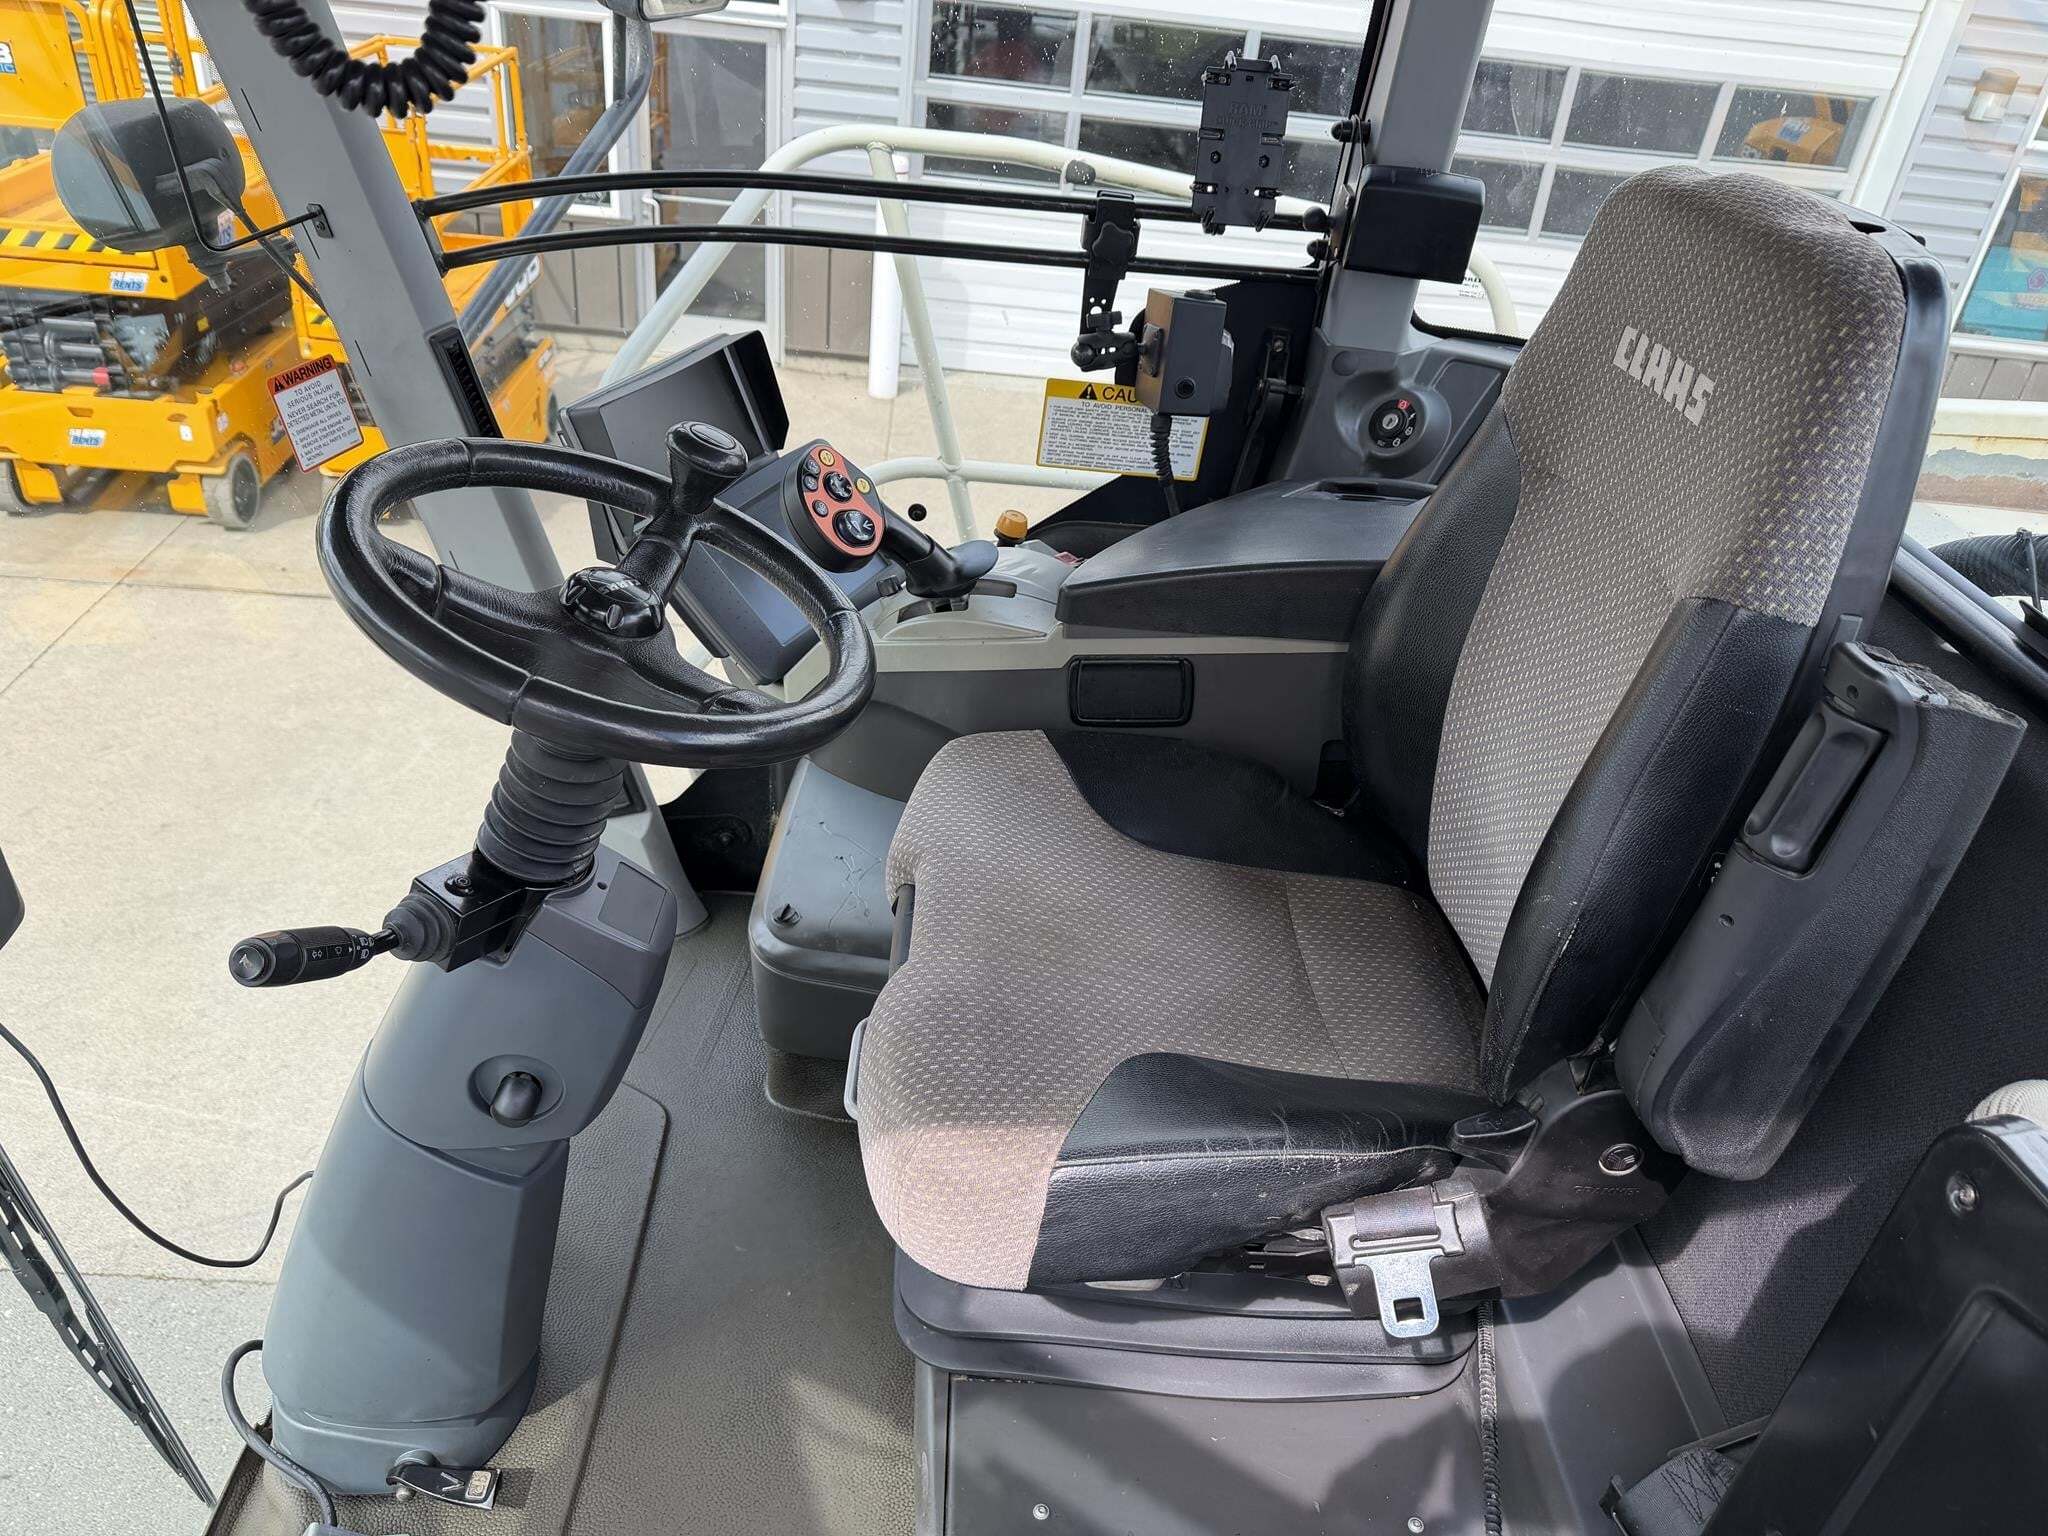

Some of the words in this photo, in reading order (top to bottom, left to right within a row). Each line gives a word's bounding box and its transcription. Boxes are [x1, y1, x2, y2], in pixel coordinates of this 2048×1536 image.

[283, 358, 331, 385] WARNING
[1612, 325, 1716, 428] CLAAS
[286, 392, 313, 408] SERIOUS
[312, 382, 334, 396] INJURY
[294, 387, 303, 396] TO
[303, 380, 321, 392] AVOID
[287, 406, 306, 419] NEVER
[306, 396, 329, 411] SEARCH
[328, 390, 340, 400] FOR
[1092, 402, 1112, 410] AVOID
[1115, 404, 1149, 414] PERSONAL
[286, 412, 310, 428] DETECTED
